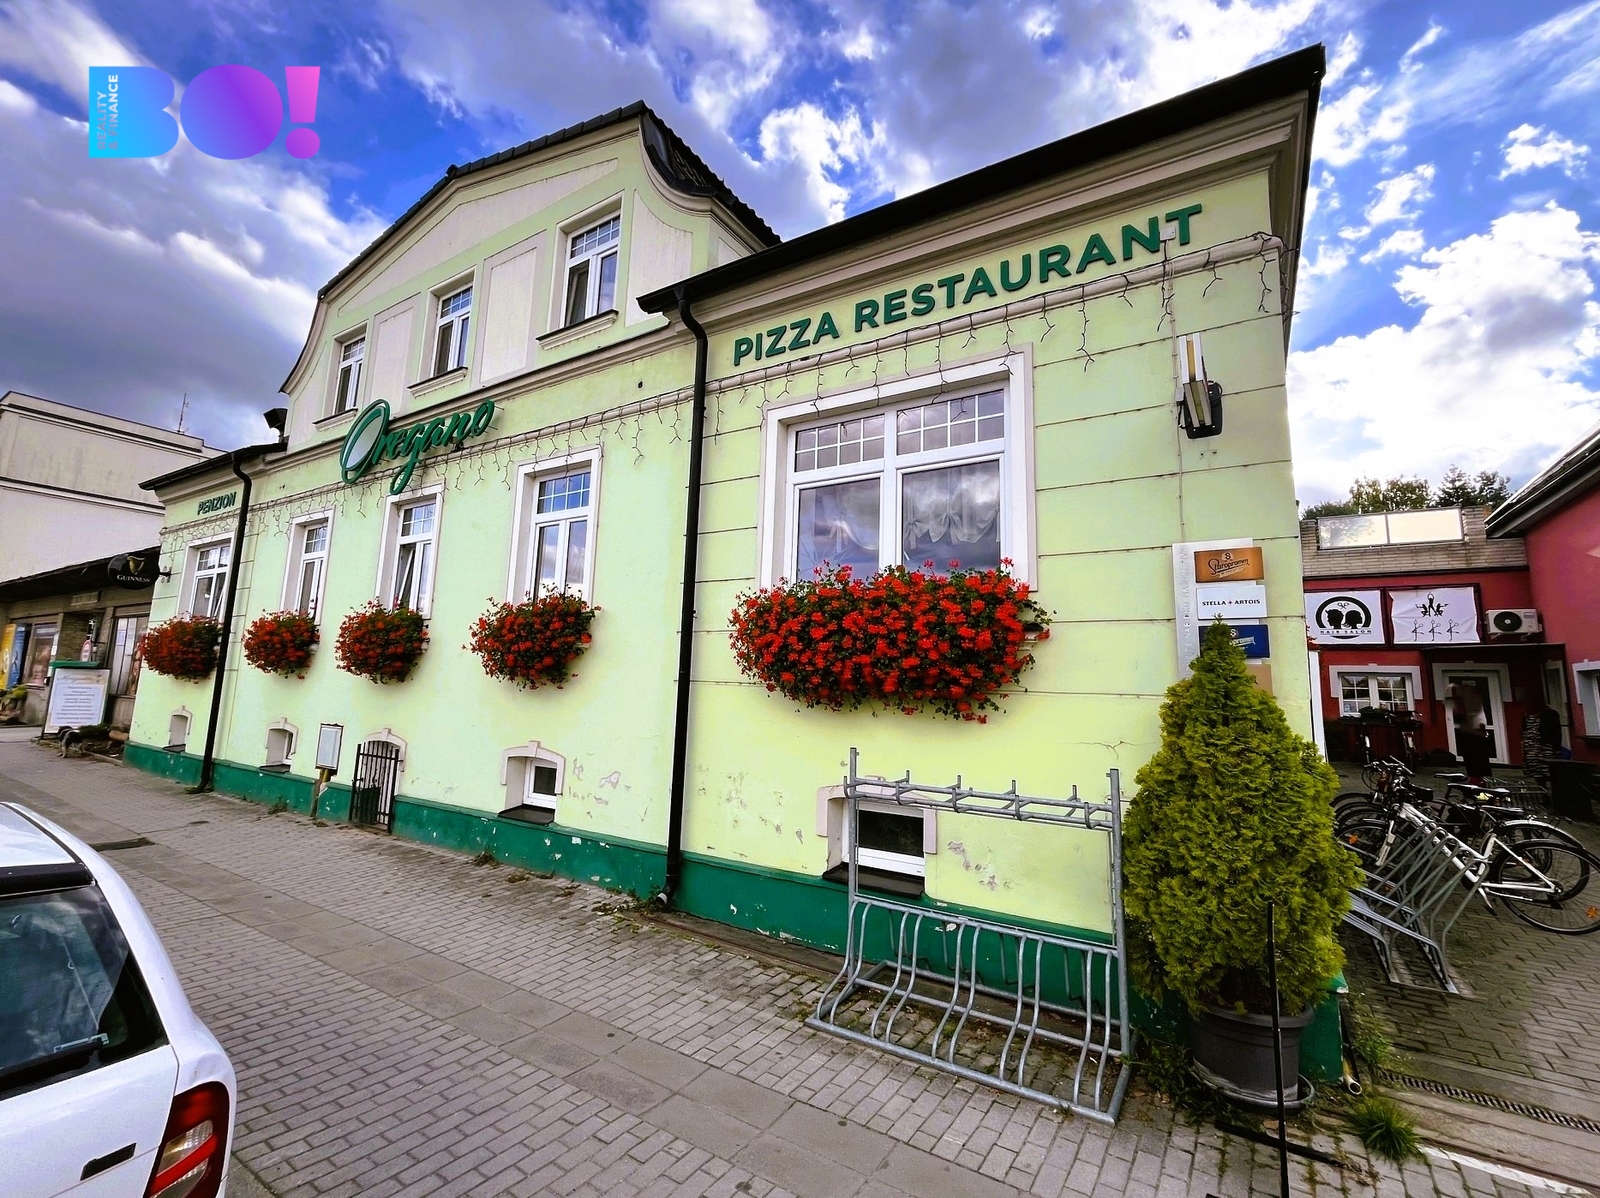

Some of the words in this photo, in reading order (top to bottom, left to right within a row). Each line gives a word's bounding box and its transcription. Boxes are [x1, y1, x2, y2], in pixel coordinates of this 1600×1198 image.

[733, 311, 839, 366] PIZZA
[854, 203, 1203, 332] RESTAURANT
[340, 398, 495, 495] Oregano
[197, 491, 238, 516] PENZION
[116, 574, 151, 583] GUINNESS
[1208, 558, 1250, 575] Staropramen
